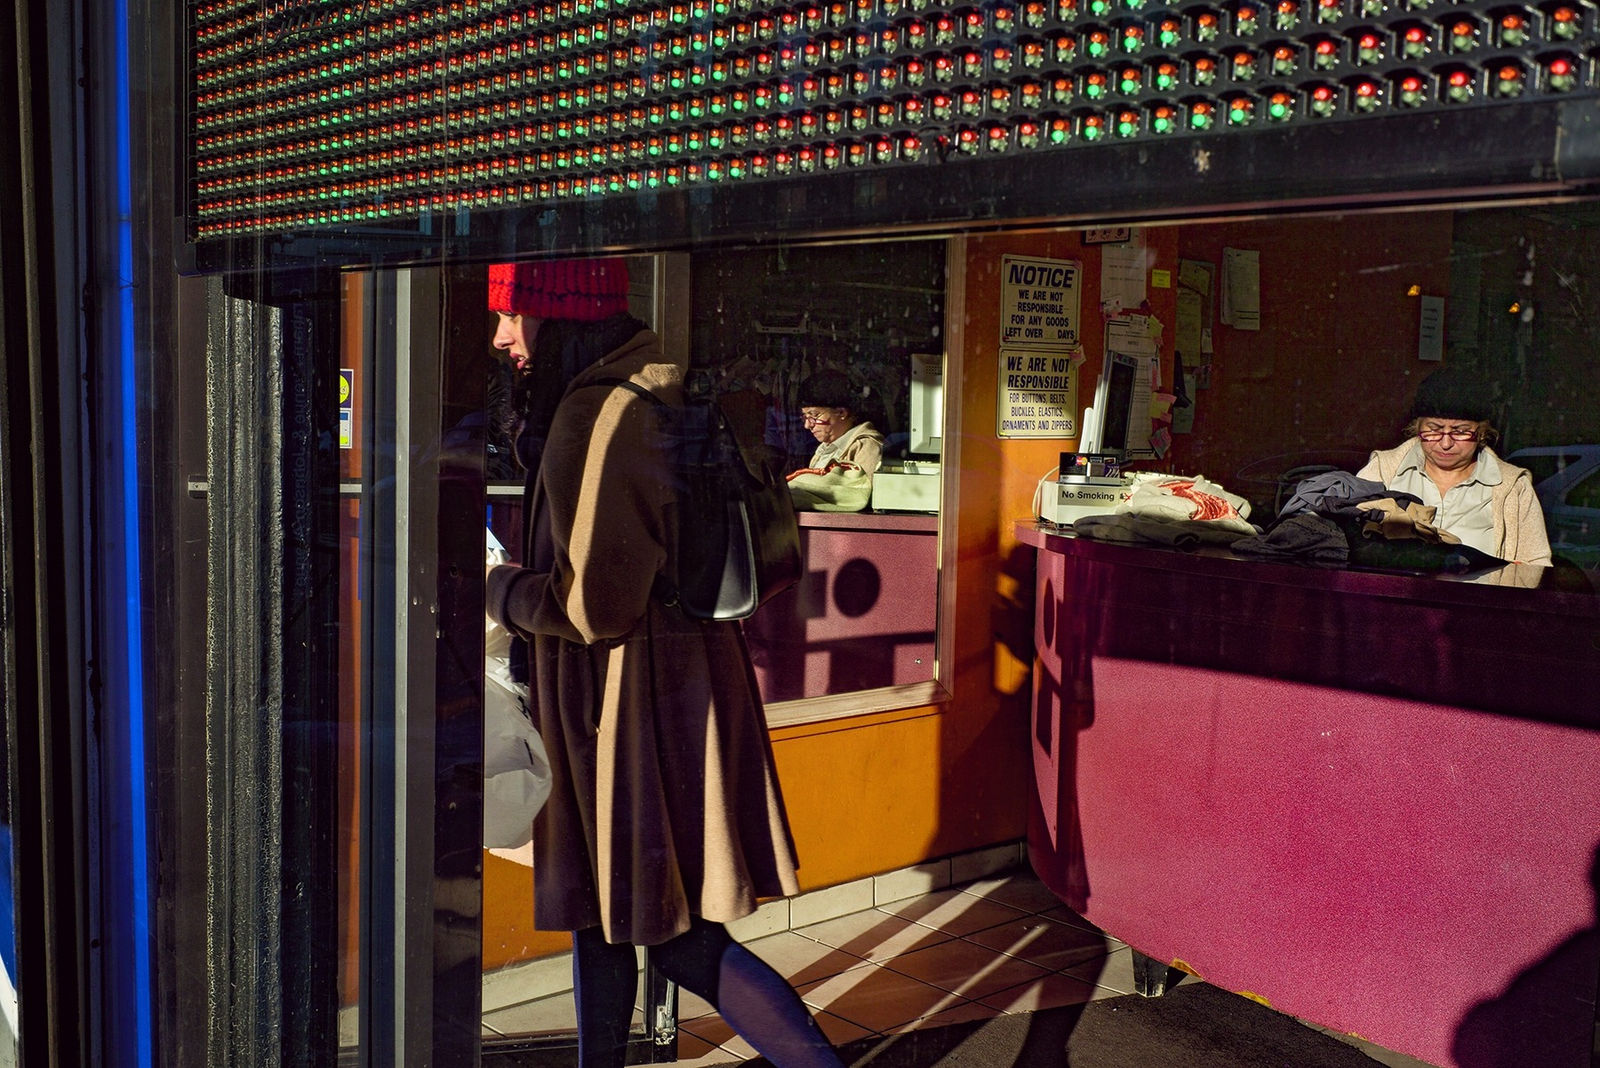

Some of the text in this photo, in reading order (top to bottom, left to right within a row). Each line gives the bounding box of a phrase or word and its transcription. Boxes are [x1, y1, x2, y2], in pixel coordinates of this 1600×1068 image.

[1009, 264, 1074, 288] NOTICE
[1019, 289, 1064, 302] WE ARE NOT
[1017, 302, 1063, 315] RESPONSIBLE
[1011, 314, 1069, 327] FOR ANY GOODS
[1005, 326, 1075, 340] LEFT OVER DAYS
[1007, 356, 1070, 373] WE ARE NOT
[1008, 374, 1069, 389] RESPONSIBLE
[1009, 392, 1067, 405] FOR BUTTONS, BELTS,
[1011, 406, 1065, 417] BUCKLES, ELASTICS,
[1002, 420, 1073, 431] ORNAMENTS AND ZIPPERS
[1061, 491, 1115, 501] No Smoking
